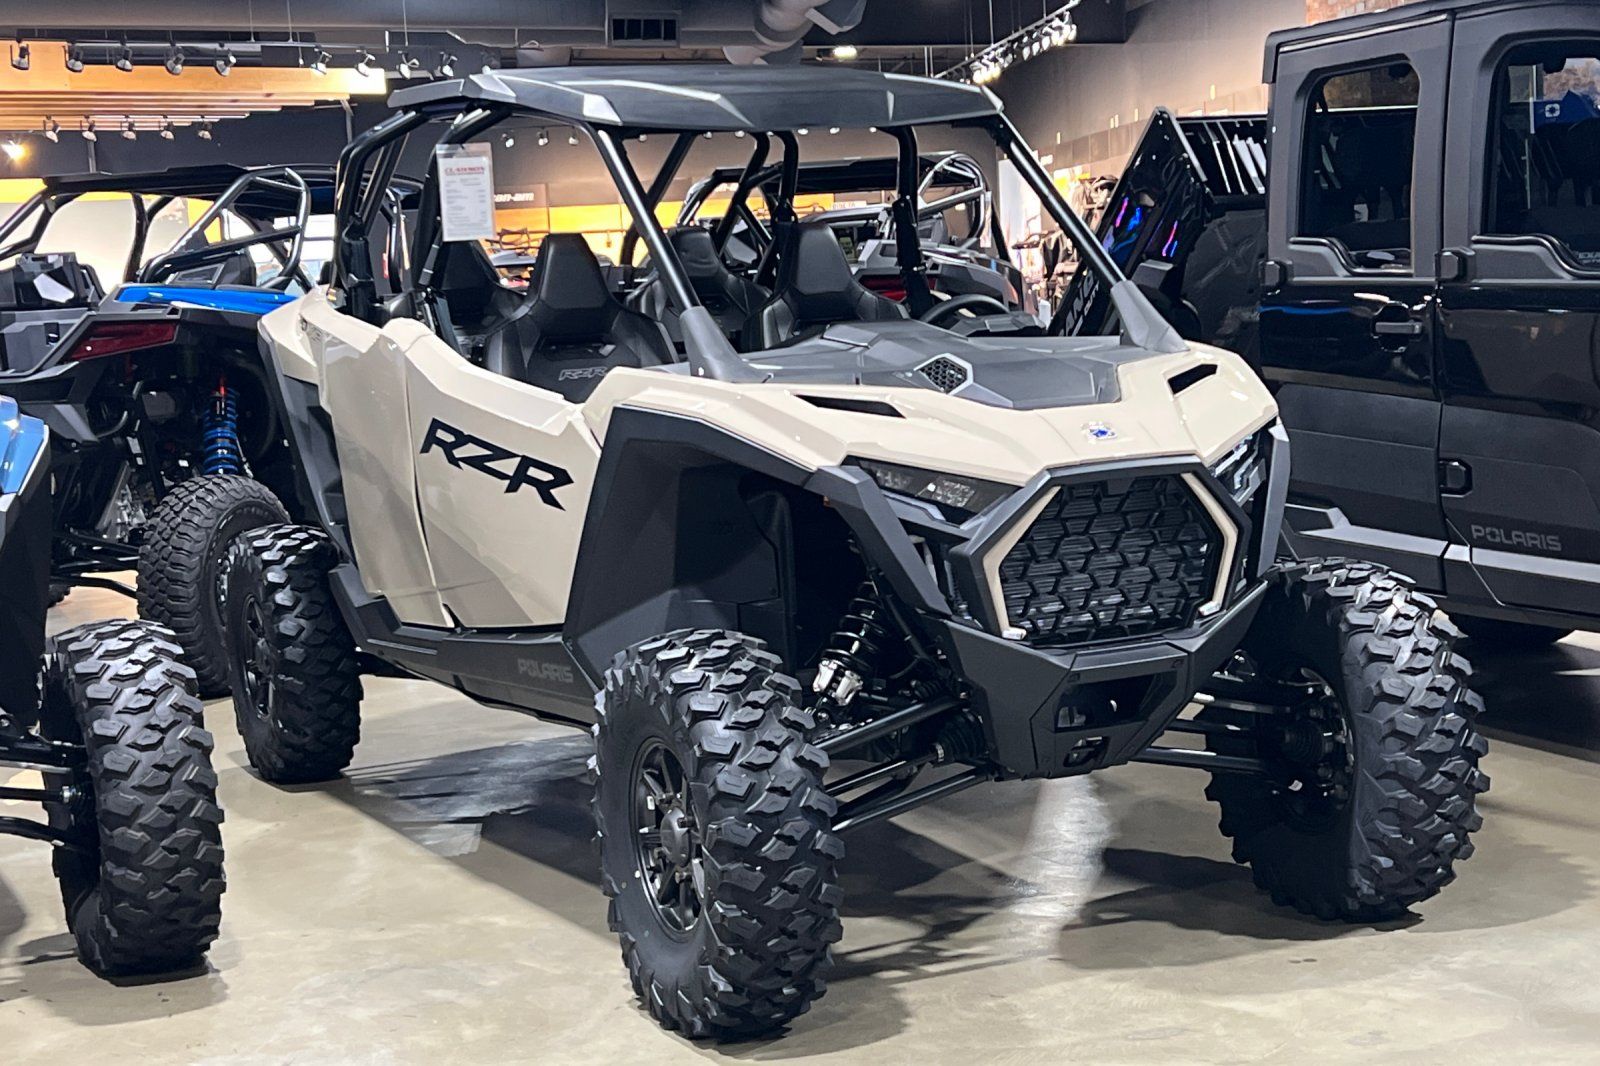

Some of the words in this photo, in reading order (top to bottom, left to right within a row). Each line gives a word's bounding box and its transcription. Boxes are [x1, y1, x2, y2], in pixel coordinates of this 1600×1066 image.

[559, 366, 607, 381] RZR
[420, 417, 574, 511] RZR
[1471, 524, 1562, 551] POLARIS
[517, 658, 573, 683] POLARIS
